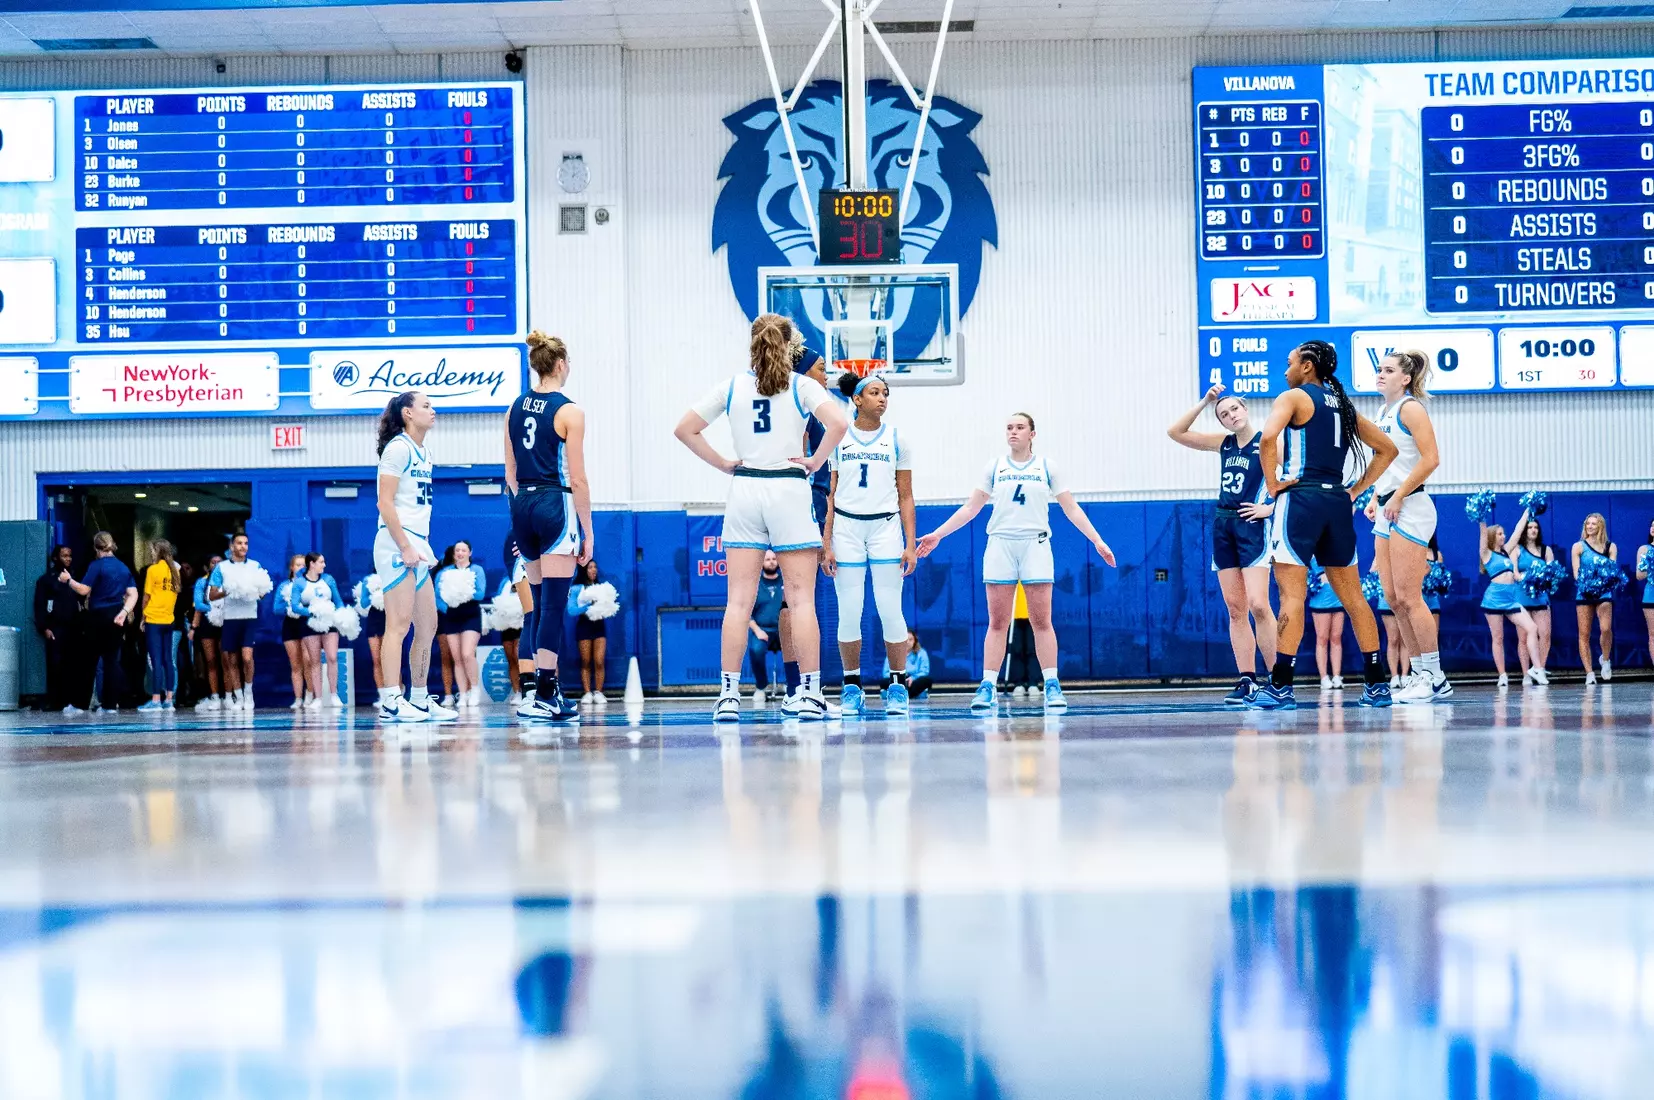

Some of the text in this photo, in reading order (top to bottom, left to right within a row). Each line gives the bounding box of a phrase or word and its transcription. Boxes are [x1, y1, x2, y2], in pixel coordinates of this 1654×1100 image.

[1224, 76, 1295, 92] VILLANOVA
[1425, 69, 1654, 97] TEAM COMPARISO
[106, 91, 488, 114] PLAYER POINTS REBOUNDS ASSISTS FOULS
[84, 118, 91, 132] 1
[106, 119, 139, 132] Jones
[218, 116, 226, 130] 0
[296, 114, 304, 128] 0
[385, 112, 393, 126] 0
[1209, 106, 1308, 122] # PTS REB F
[1450, 109, 1652, 133] 0 FG% 0
[84, 137, 92, 150] 3
[107, 137, 138, 150] Olsen
[218, 134, 226, 148] 0
[297, 132, 304, 146] 0
[386, 131, 394, 145] 0
[1210, 131, 1309, 147] 1 0 0 0
[84, 156, 98, 170] 10
[218, 154, 226, 168] 0
[297, 152, 304, 165] 0
[386, 150, 394, 164] 0
[1210, 157, 1310, 173] 3 0 0 0
[1451, 143, 1653, 168] 0 3FG% 0
[85, 175, 99, 188] 23
[108, 175, 140, 188] Burke
[218, 172, 226, 186] 0
[297, 170, 305, 184] 0
[386, 169, 394, 182] 0
[85, 194, 99, 207] 32
[108, 194, 147, 209] Runyan
[218, 191, 226, 205] 0
[297, 189, 305, 203] 0
[386, 188, 394, 201] 0
[1206, 183, 1310, 199] 10 0 0 0
[1452, 178, 1654, 203] 0 REBOUNDS 0
[834, 195, 892, 217] 10:00
[1207, 208, 1311, 225] 23 0 0 0
[1453, 216, 1466, 234] 0
[1510, 213, 1596, 237] ASSISTS
[108, 223, 489, 244] PLAYER POINTS REBOUNDS ASSISTS FOULS
[840, 220, 882, 259] 30
[1207, 234, 1312, 251] 32 0 0 0
[85, 249, 92, 263] 1
[108, 249, 135, 264] Page
[219, 247, 227, 260] 0
[298, 245, 306, 258] 0
[387, 243, 395, 257] 0
[1454, 251, 1467, 268] 0
[1518, 247, 1591, 271] STEALS
[85, 268, 93, 282] 3
[108, 267, 146, 281] Collins
[219, 266, 227, 280] 0
[298, 264, 306, 278] 0
[387, 262, 395, 276] 0
[86, 287, 93, 300] 4
[108, 286, 166, 300] Henderson
[219, 285, 227, 298] 0
[298, 283, 306, 296] 0
[388, 281, 395, 295] 0
[1455, 286, 1468, 304] 0
[1495, 282, 1615, 307] TURNOVERS
[86, 306, 99, 320] 10
[109, 305, 166, 319] Henderson
[220, 304, 227, 318] 0
[299, 302, 306, 316] 0
[388, 300, 395, 314] 0
[86, 324, 100, 339] 35
[109, 324, 130, 338] Hsu
[220, 323, 227, 337] 0
[299, 321, 306, 335] 0
[388, 319, 395, 333] 0
[1210, 337, 1267, 357] 0 FOULS
[1520, 339, 1595, 358] 10:00
[1437, 347, 1458, 371] 0
[123, 364, 216, 382] NewYork-
[368, 357, 506, 396] Academy
[1210, 361, 1268, 385] 4 TIME
[1517, 369, 1596, 382] 1ST 30
[1233, 378, 1269, 393] OUTS
[123, 384, 244, 408] Presbyterian
[522, 397, 547, 414] OLSEN
[1323, 393, 1338, 408] JON
[753, 399, 771, 433] 3
[274, 426, 303, 447] EXIT
[523, 417, 537, 449] 3
[1333, 412, 1341, 448] 1
[858, 464, 868, 488] 1
[1222, 472, 1245, 494] 23
[1012, 484, 1026, 505] 4
[703, 536, 723, 552] FI
[698, 560, 728, 576] HO
